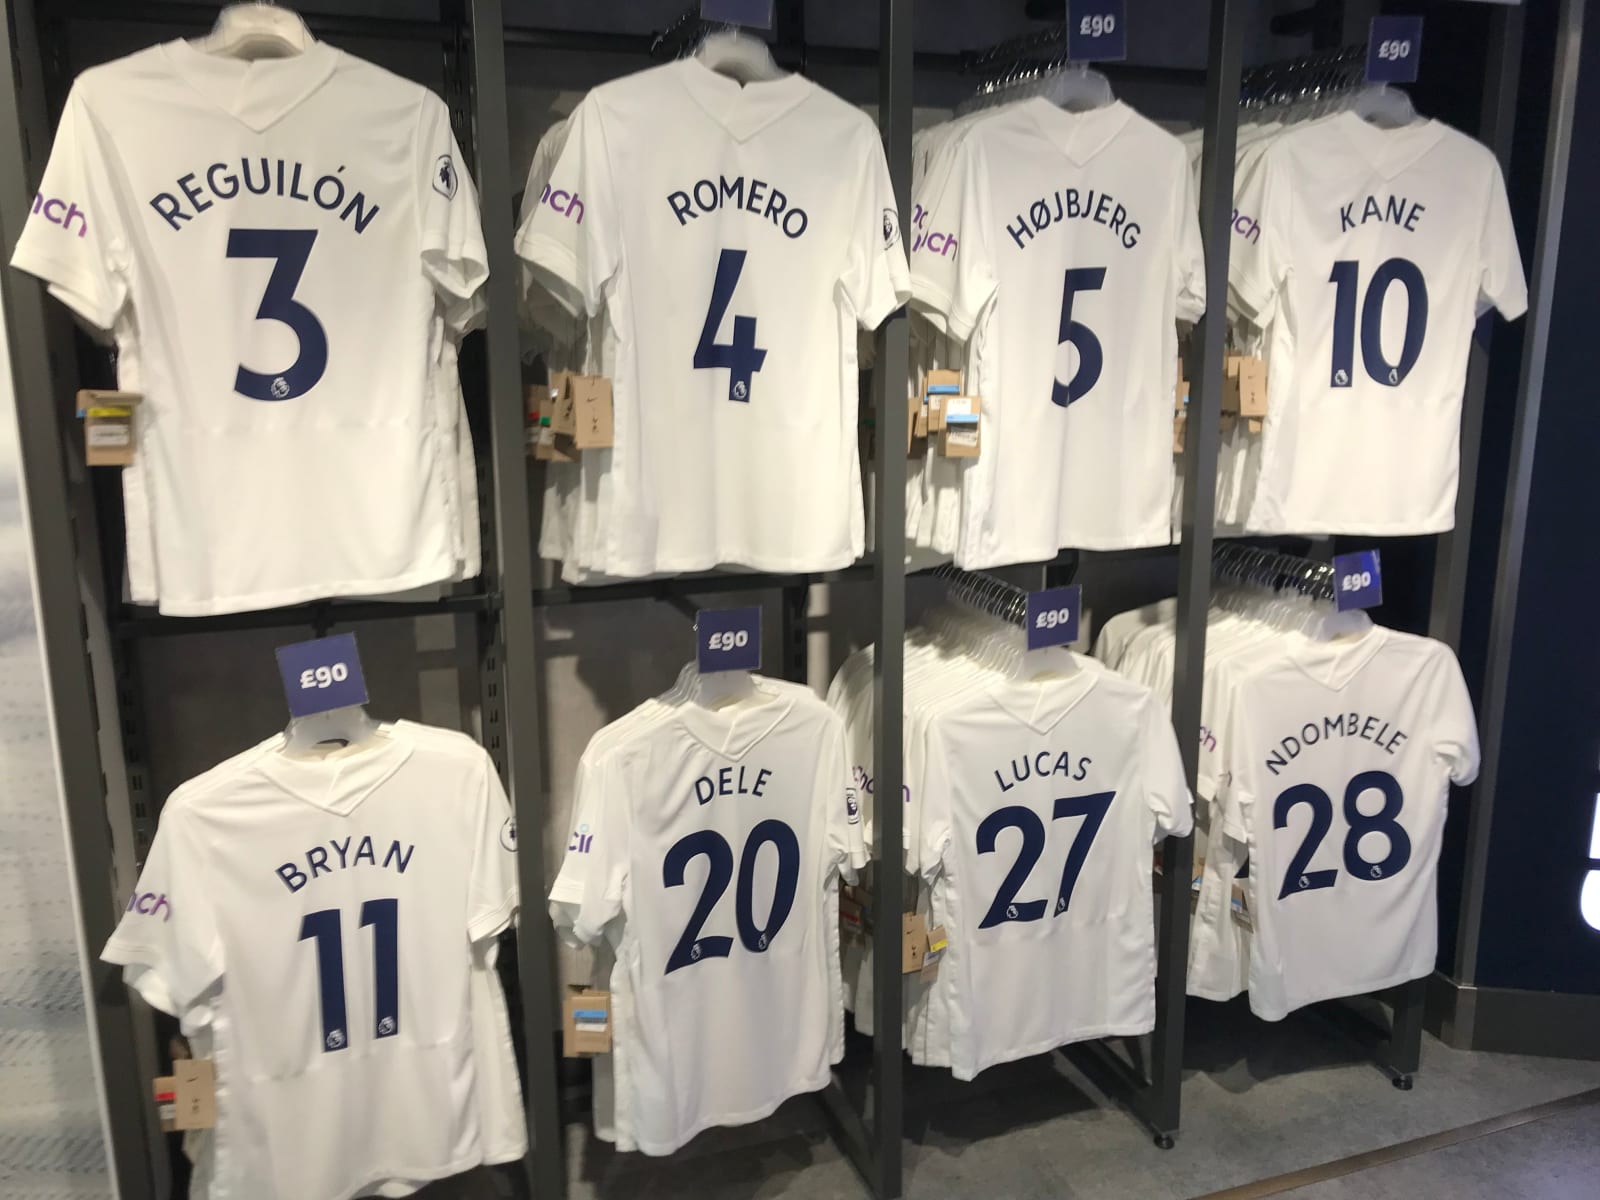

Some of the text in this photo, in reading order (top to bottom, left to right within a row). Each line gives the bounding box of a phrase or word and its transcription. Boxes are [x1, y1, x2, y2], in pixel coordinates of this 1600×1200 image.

[1080, 15, 1115, 36] £90
[1378, 40, 1410, 60] £90
[149, 158, 380, 236] REGUILÓN
[667, 175, 808, 239] ROMERO
[1006, 188, 1142, 250] HØJBJERG
[1340, 195, 1427, 233] KANE
[226, 229, 329, 402] 3
[693, 248, 768, 403] 4
[1051, 266, 1107, 408] 5
[1328, 257, 1429, 388] 10
[1341, 571, 1371, 592] £90
[708, 629, 749, 652] £90
[1035, 607, 1070, 629] £90
[299, 661, 350, 690] £90
[994, 751, 1093, 793] LUCAS
[1265, 712, 1408, 776] NDOMBELE
[694, 765, 773, 806] DELE
[275, 835, 415, 894] BRYAN
[975, 790, 1117, 930] 27
[1272, 770, 1412, 901] 28
[662, 818, 801, 976] 20
[297, 897, 399, 1054] 11
